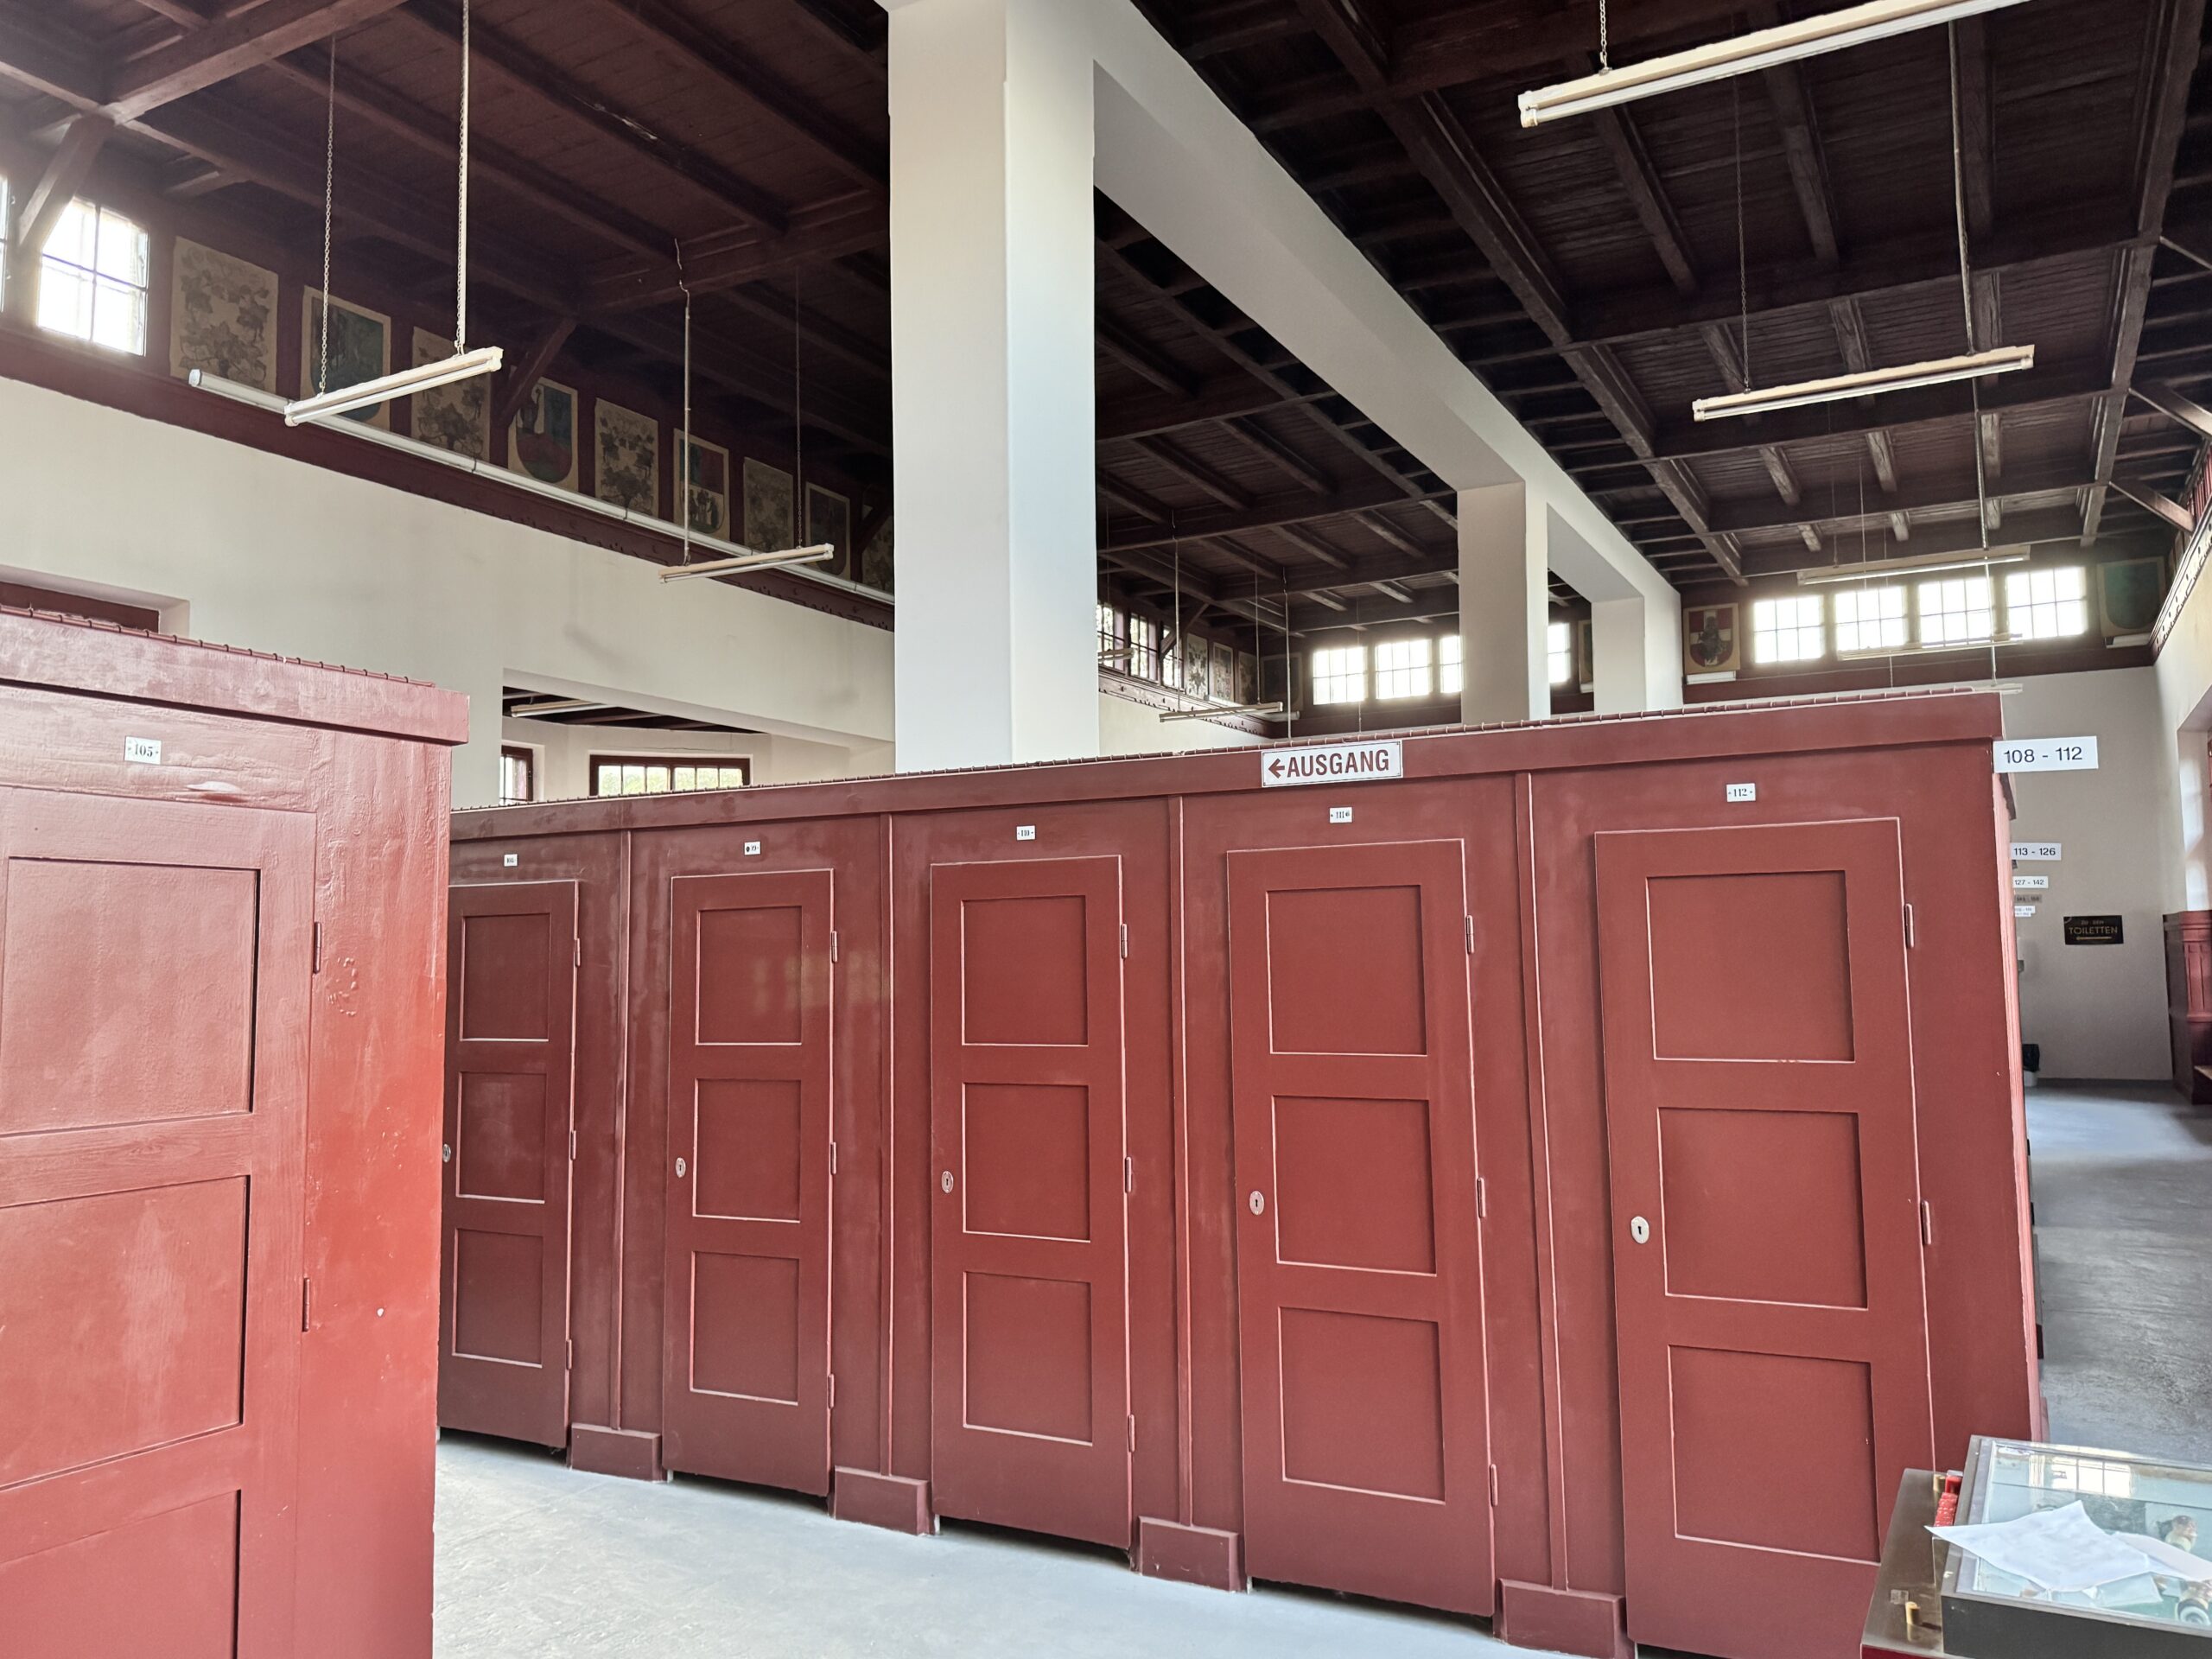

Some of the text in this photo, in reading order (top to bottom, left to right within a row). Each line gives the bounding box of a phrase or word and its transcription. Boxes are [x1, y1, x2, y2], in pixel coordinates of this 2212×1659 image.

[135, 744, 154, 757] 105
[2004, 749, 2035, 764] 108
[2056, 747, 2082, 761] 112
[1287, 749, 1389, 778] AUSGANG
[1733, 788, 1747, 797] 112
[2069, 925, 2118, 934] TOILETTEN
